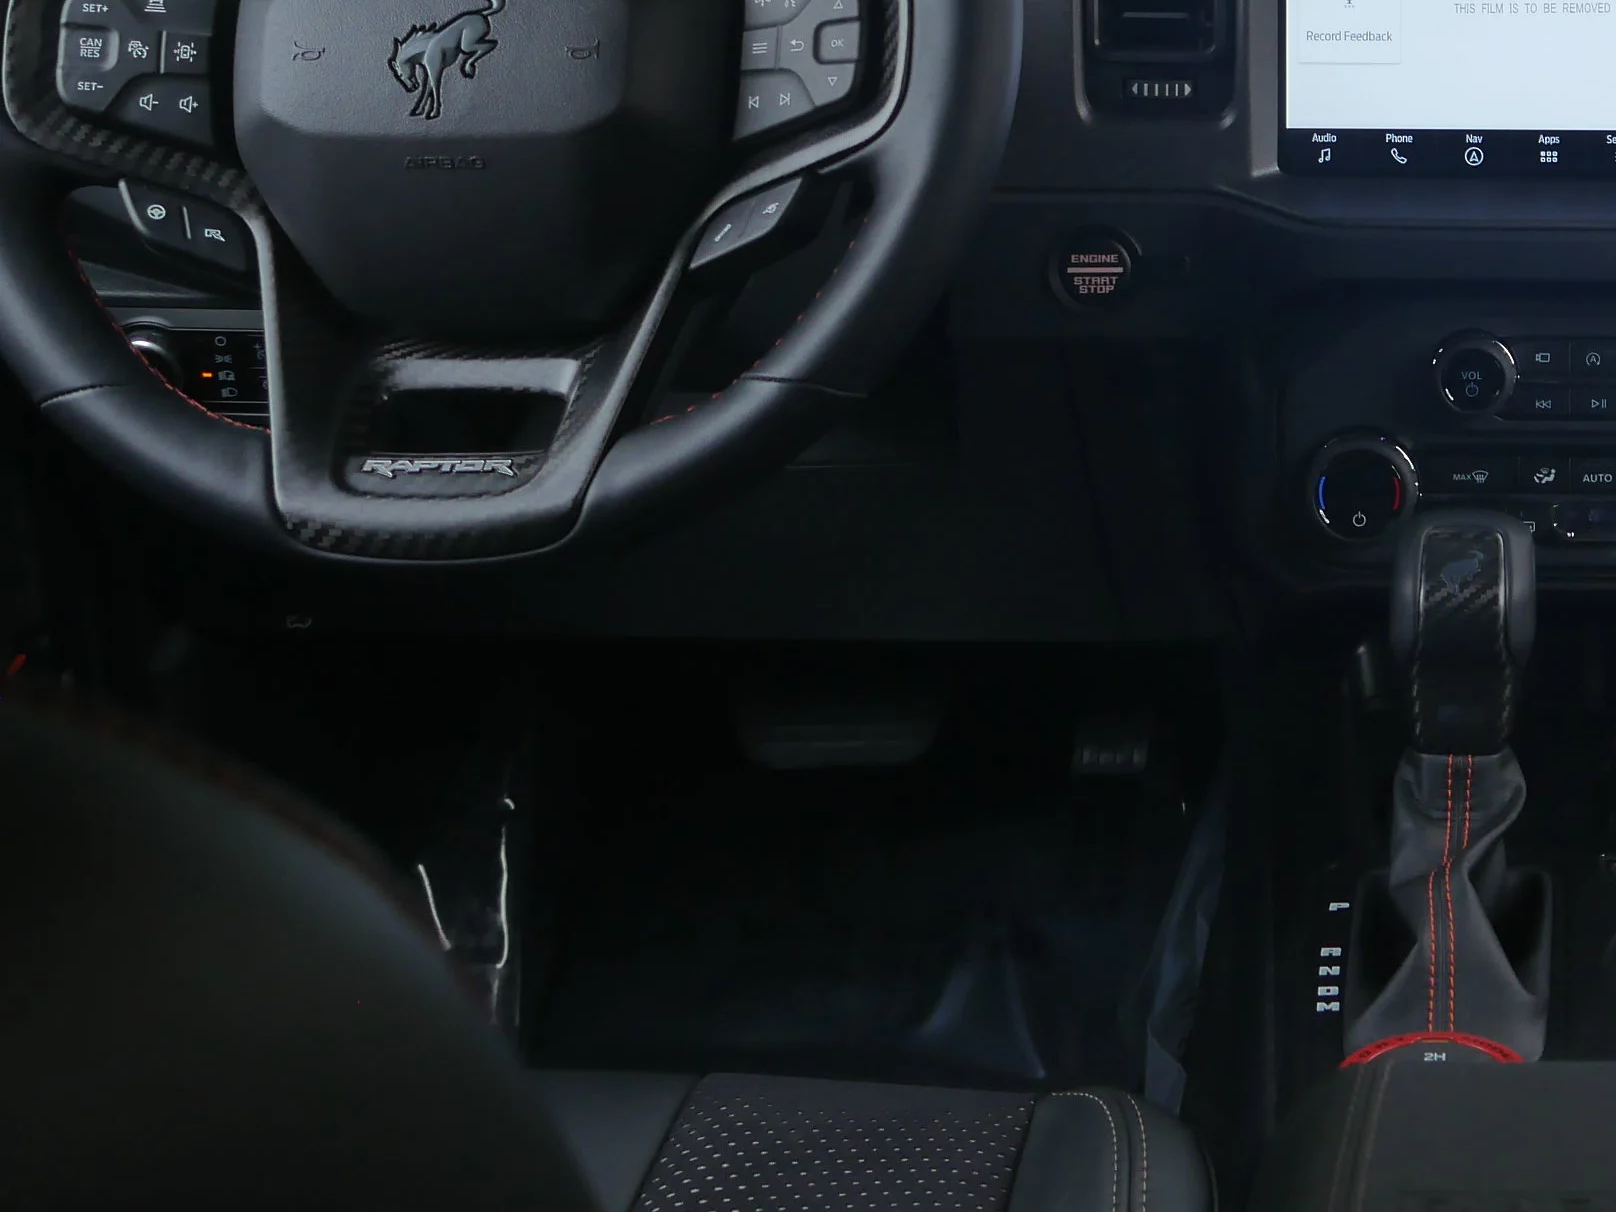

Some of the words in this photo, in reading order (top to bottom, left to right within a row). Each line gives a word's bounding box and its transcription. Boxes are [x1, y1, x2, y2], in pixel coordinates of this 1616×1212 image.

[82, 3, 109, 13] SET+
[1454, 3, 1476, 14] THIS
[1481, 3, 1504, 14] FILM
[1509, 3, 1519, 14] IS
[1525, 3, 1537, 14] TO
[1543, 3, 1556, 14] BE
[1562, 3, 1611, 14] REMOVED
[1306, 30, 1342, 41] Record
[1343, 30, 1393, 42] Feedback
[79, 37, 103, 47] CAN
[831, 38, 844, 47] OK
[79, 48, 100, 58] RES
[1311, 133, 1337, 143] Audio
[1385, 133, 1413, 143] Phone
[1465, 134, 1483, 143] Nav
[1538, 134, 1560, 145] Apps
[404, 154, 487, 170] AIRBAG
[1070, 254, 1119, 264] ENGINE
[1073, 276, 1118, 285] START
[1079, 285, 1114, 294] STOP
[1461, 371, 1482, 380] VOL
[360, 459, 517, 478] RAPTOR
[1453, 472, 1472, 482] MAX
[1582, 473, 1613, 483] AUTO
[1328, 902, 1350, 911] P
[1320, 947, 1342, 956] R
[1318, 966, 1341, 976] N
[1317, 986, 1339, 996] D
[1316, 1001, 1340, 1012] M
[1423, 1052, 1446, 1061] 2H
